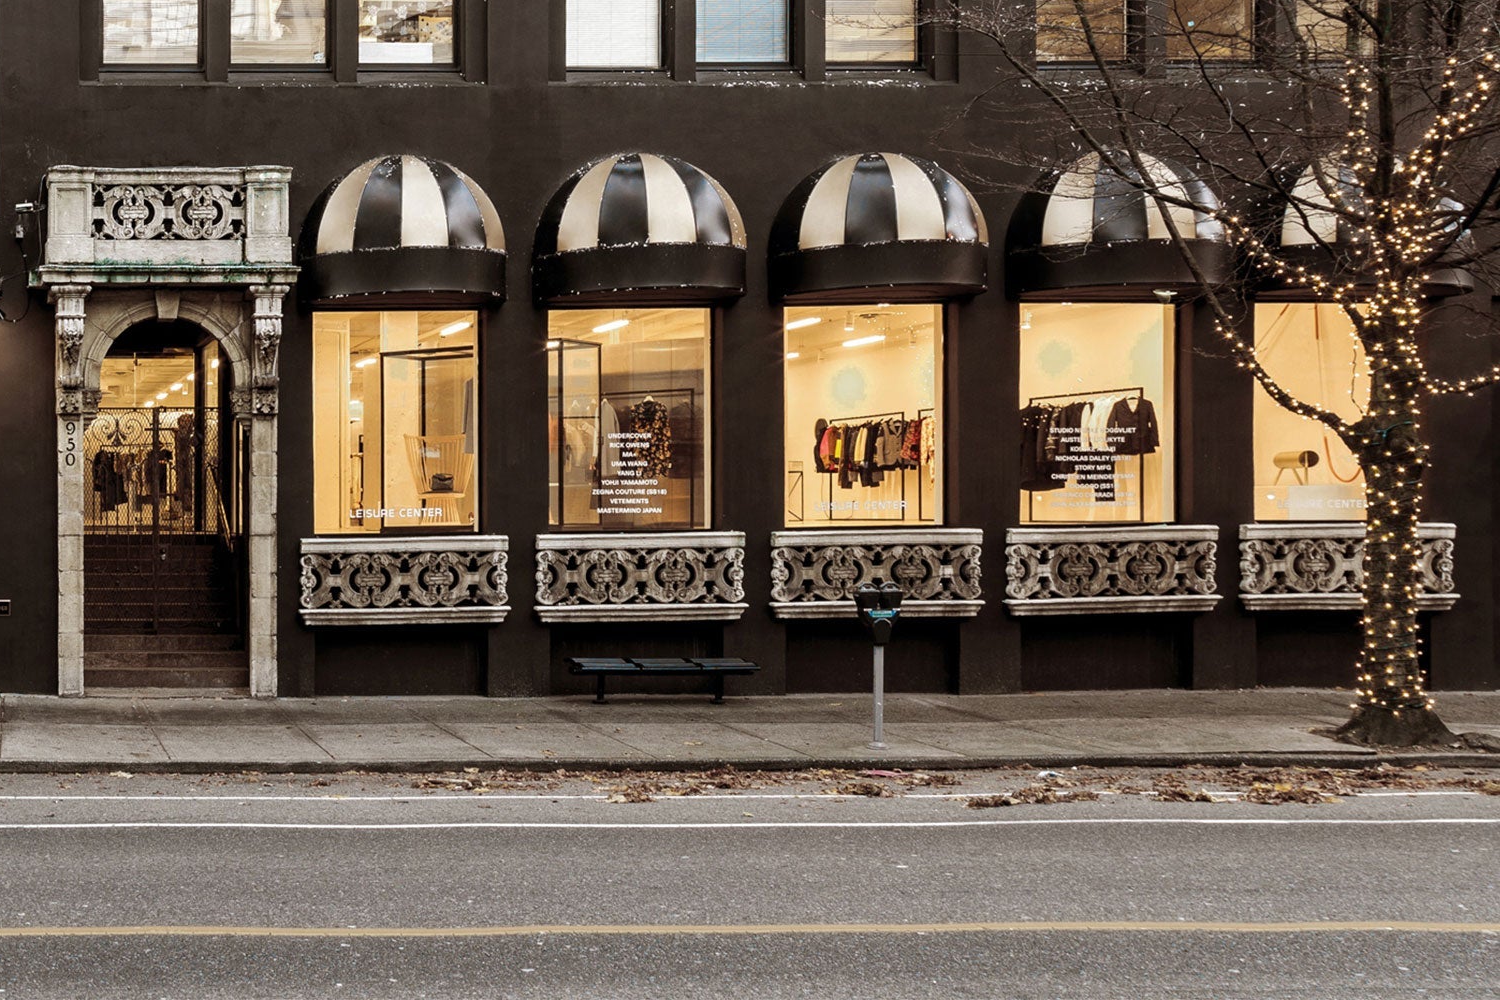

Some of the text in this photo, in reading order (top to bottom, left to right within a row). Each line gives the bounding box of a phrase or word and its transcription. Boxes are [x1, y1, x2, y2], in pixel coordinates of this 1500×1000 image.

[65, 421, 76, 466] 950
[864, 500, 907, 510] CENTER
[349, 507, 442, 519] LEISURE CENTER
